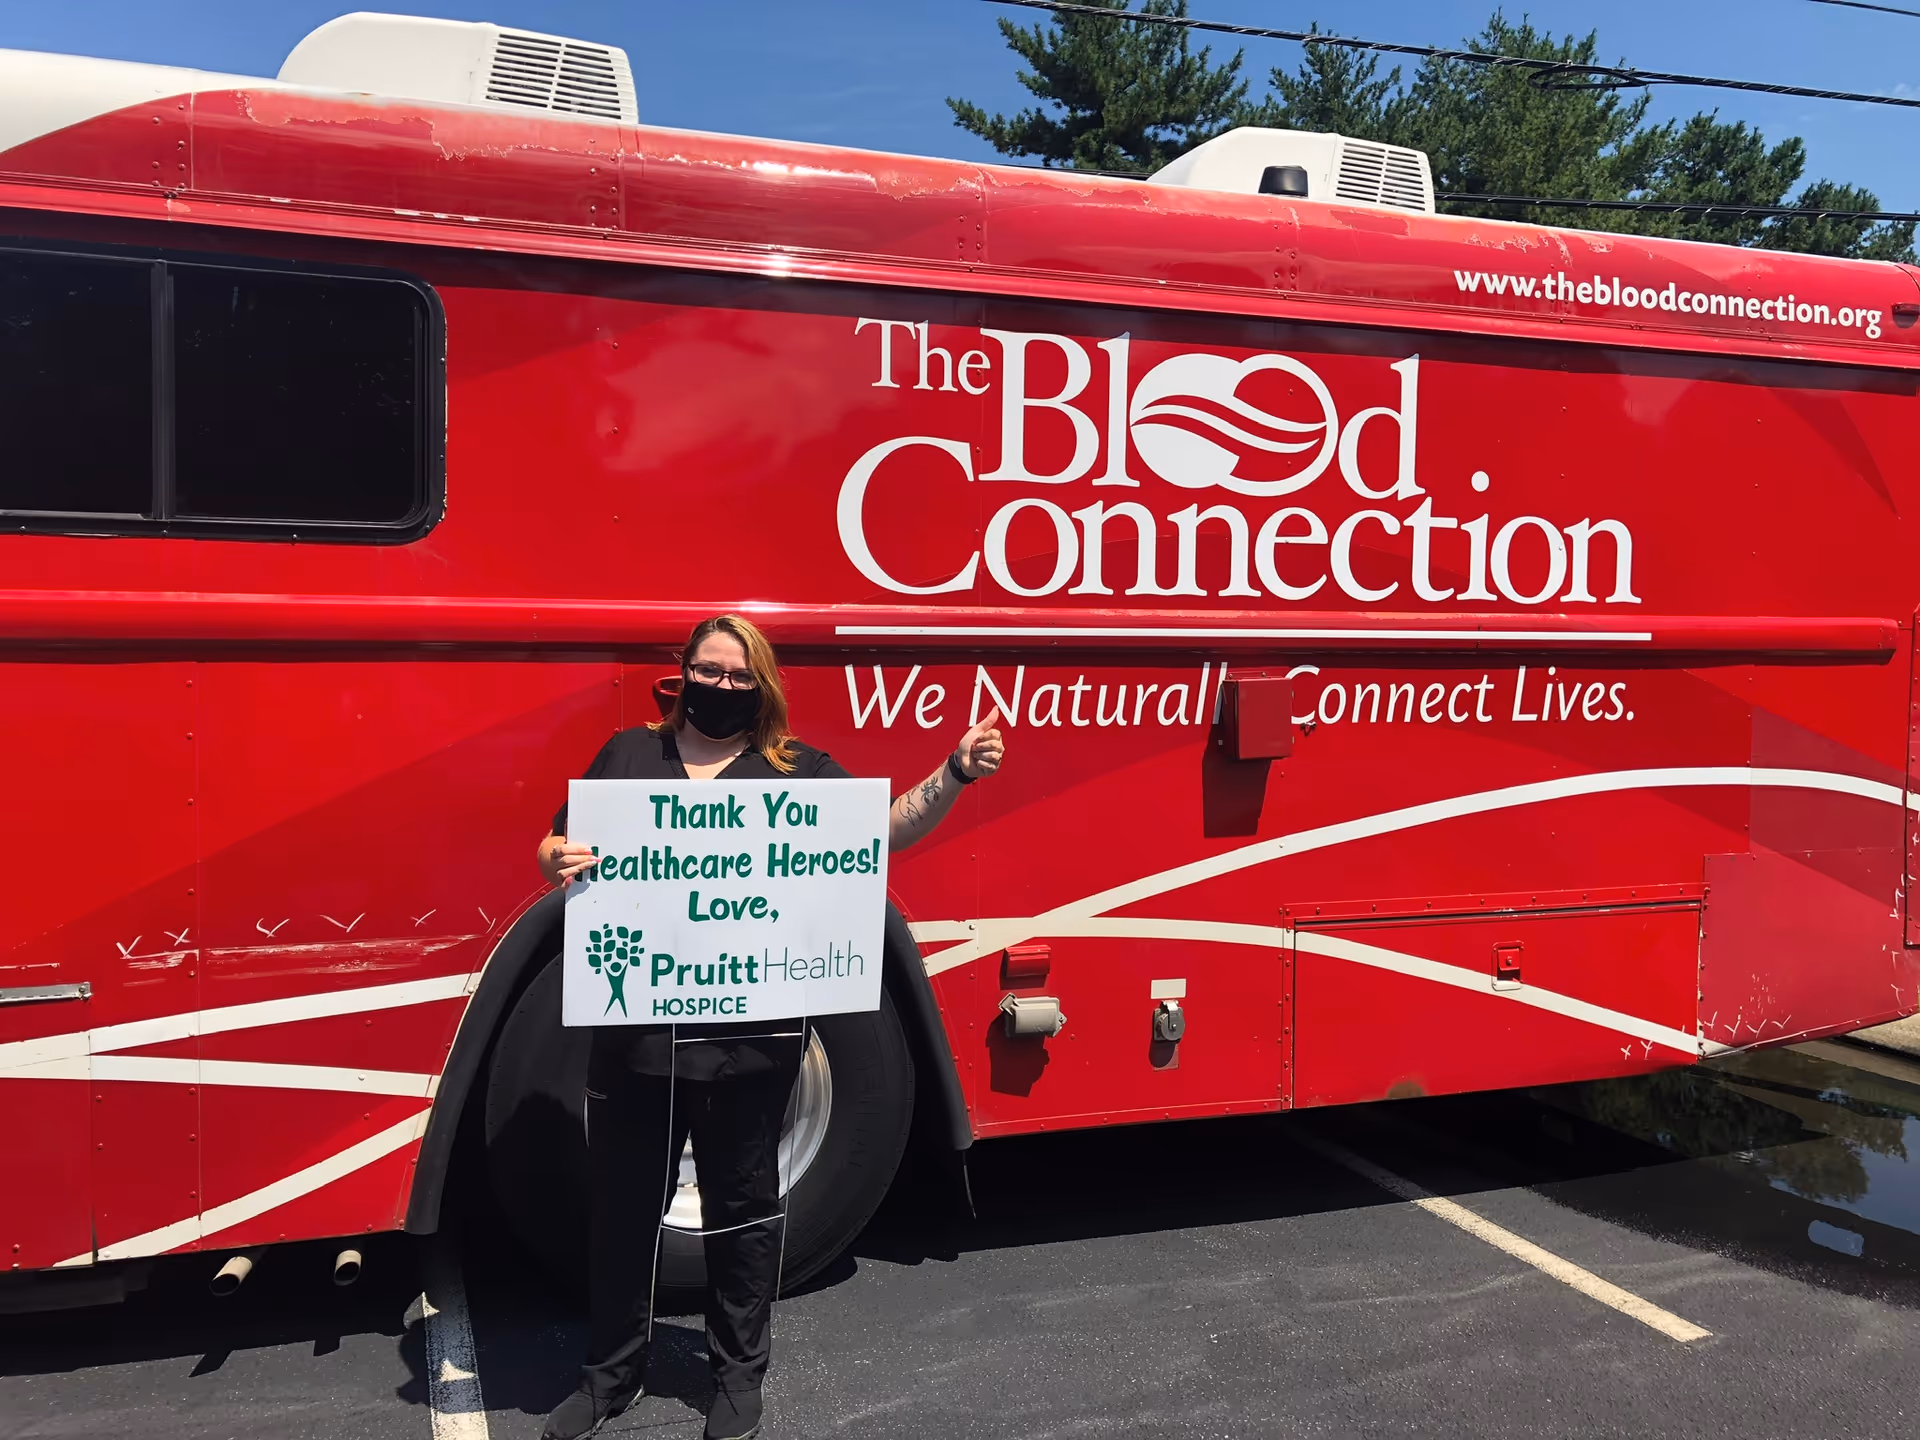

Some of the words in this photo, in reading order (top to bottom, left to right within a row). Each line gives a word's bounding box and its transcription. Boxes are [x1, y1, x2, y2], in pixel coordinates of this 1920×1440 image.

[1454, 270, 1882, 339] www.thebloodconnection.org
[855, 317, 991, 395] The
[836, 436, 1642, 605] Connection
[844, 663, 946, 729] We
[971, 661, 1229, 728] Naturall
[1511, 665, 1634, 722] Lives.
[649, 794, 745, 829] Thank
[762, 790, 818, 828] You
[766, 837, 881, 878] Heroes!
[688, 890, 780, 923] Love,
[652, 996, 747, 1016] HOSPICE
